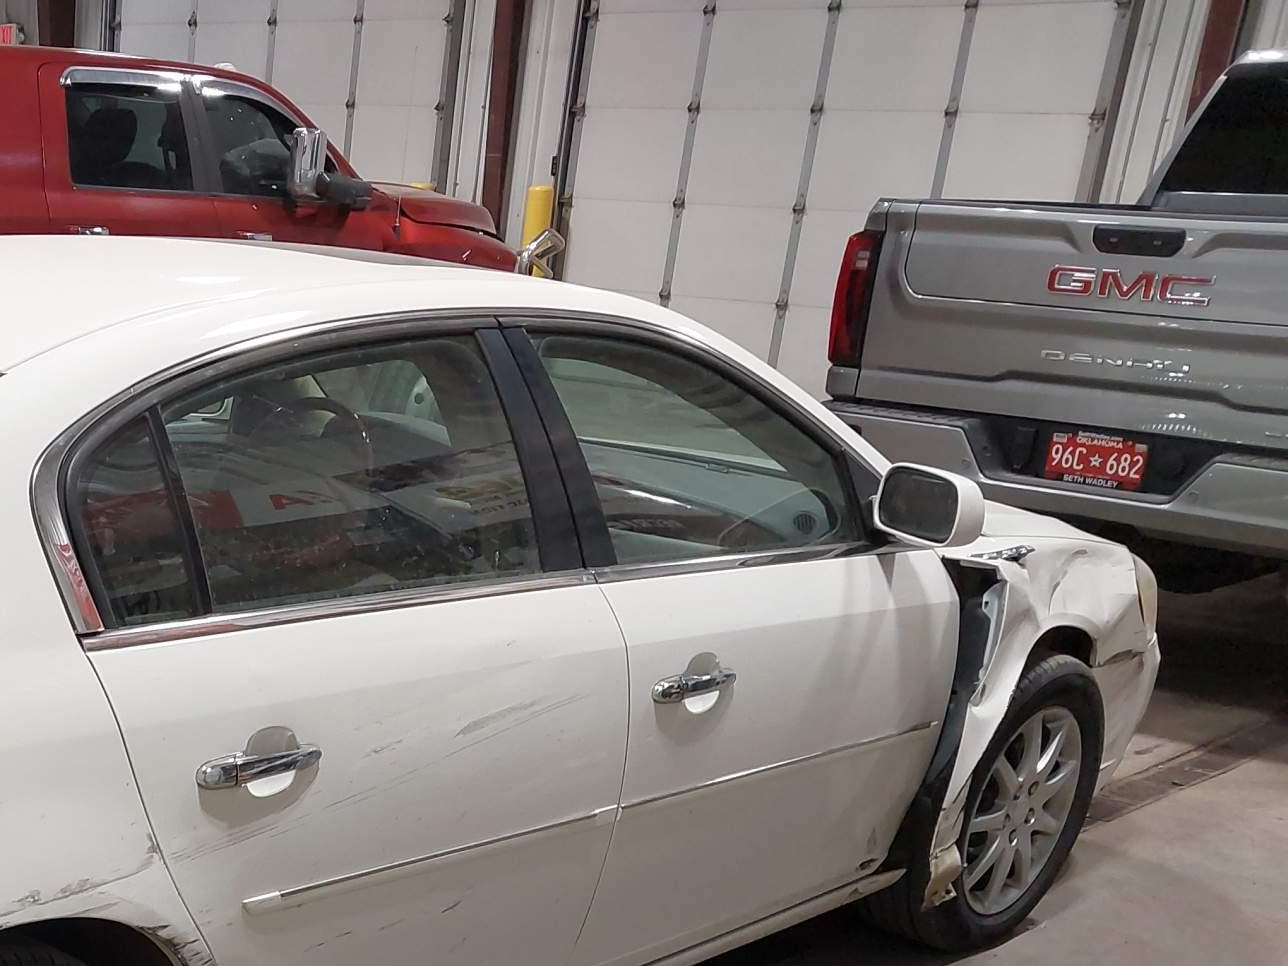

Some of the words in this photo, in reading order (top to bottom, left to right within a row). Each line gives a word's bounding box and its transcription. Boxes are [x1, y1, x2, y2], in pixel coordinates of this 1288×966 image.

[1047, 264, 1216, 307] GMC
[1076, 437, 1123, 449] OKLAHOMA
[1051, 444, 1087, 470] 96C
[1106, 452, 1144, 478] 682
[1063, 474, 1084, 482] SETH
[1086, 476, 1118, 488] WADLEY
